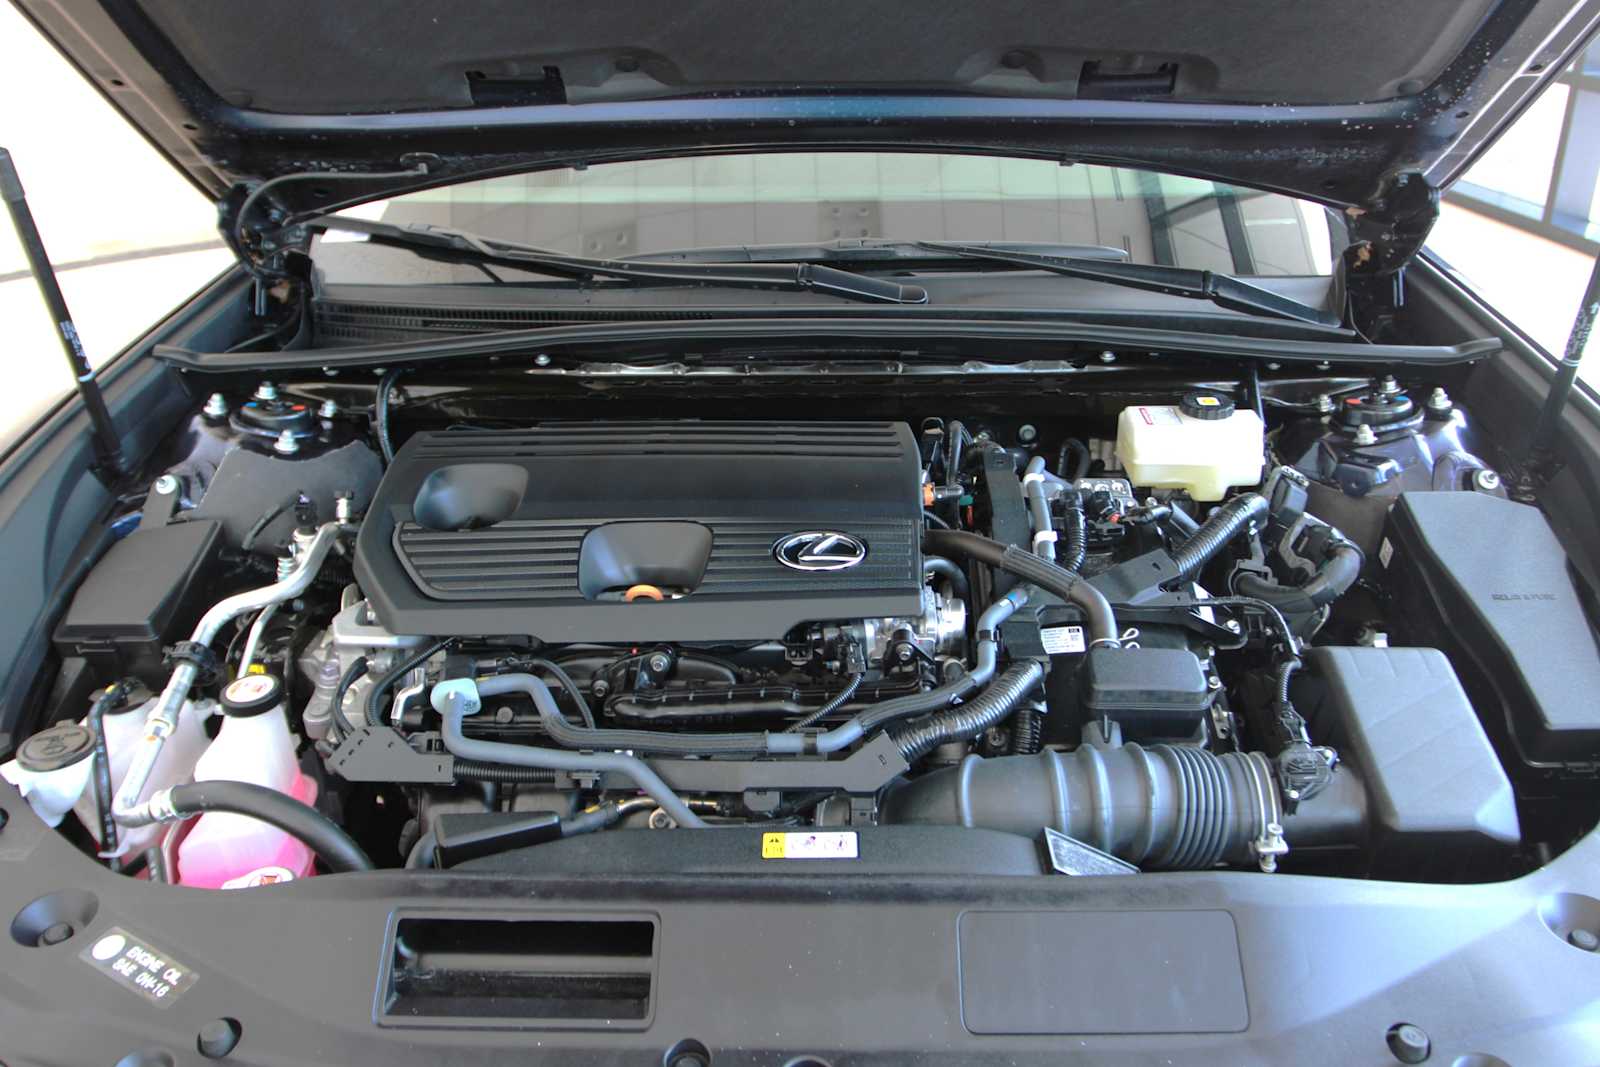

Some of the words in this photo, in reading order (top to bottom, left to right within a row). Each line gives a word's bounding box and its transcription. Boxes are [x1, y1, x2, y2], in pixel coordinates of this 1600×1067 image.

[112, 958, 138, 977] SAE
[126, 946, 165, 973] ENGINE
[163, 968, 182, 986] OIL
